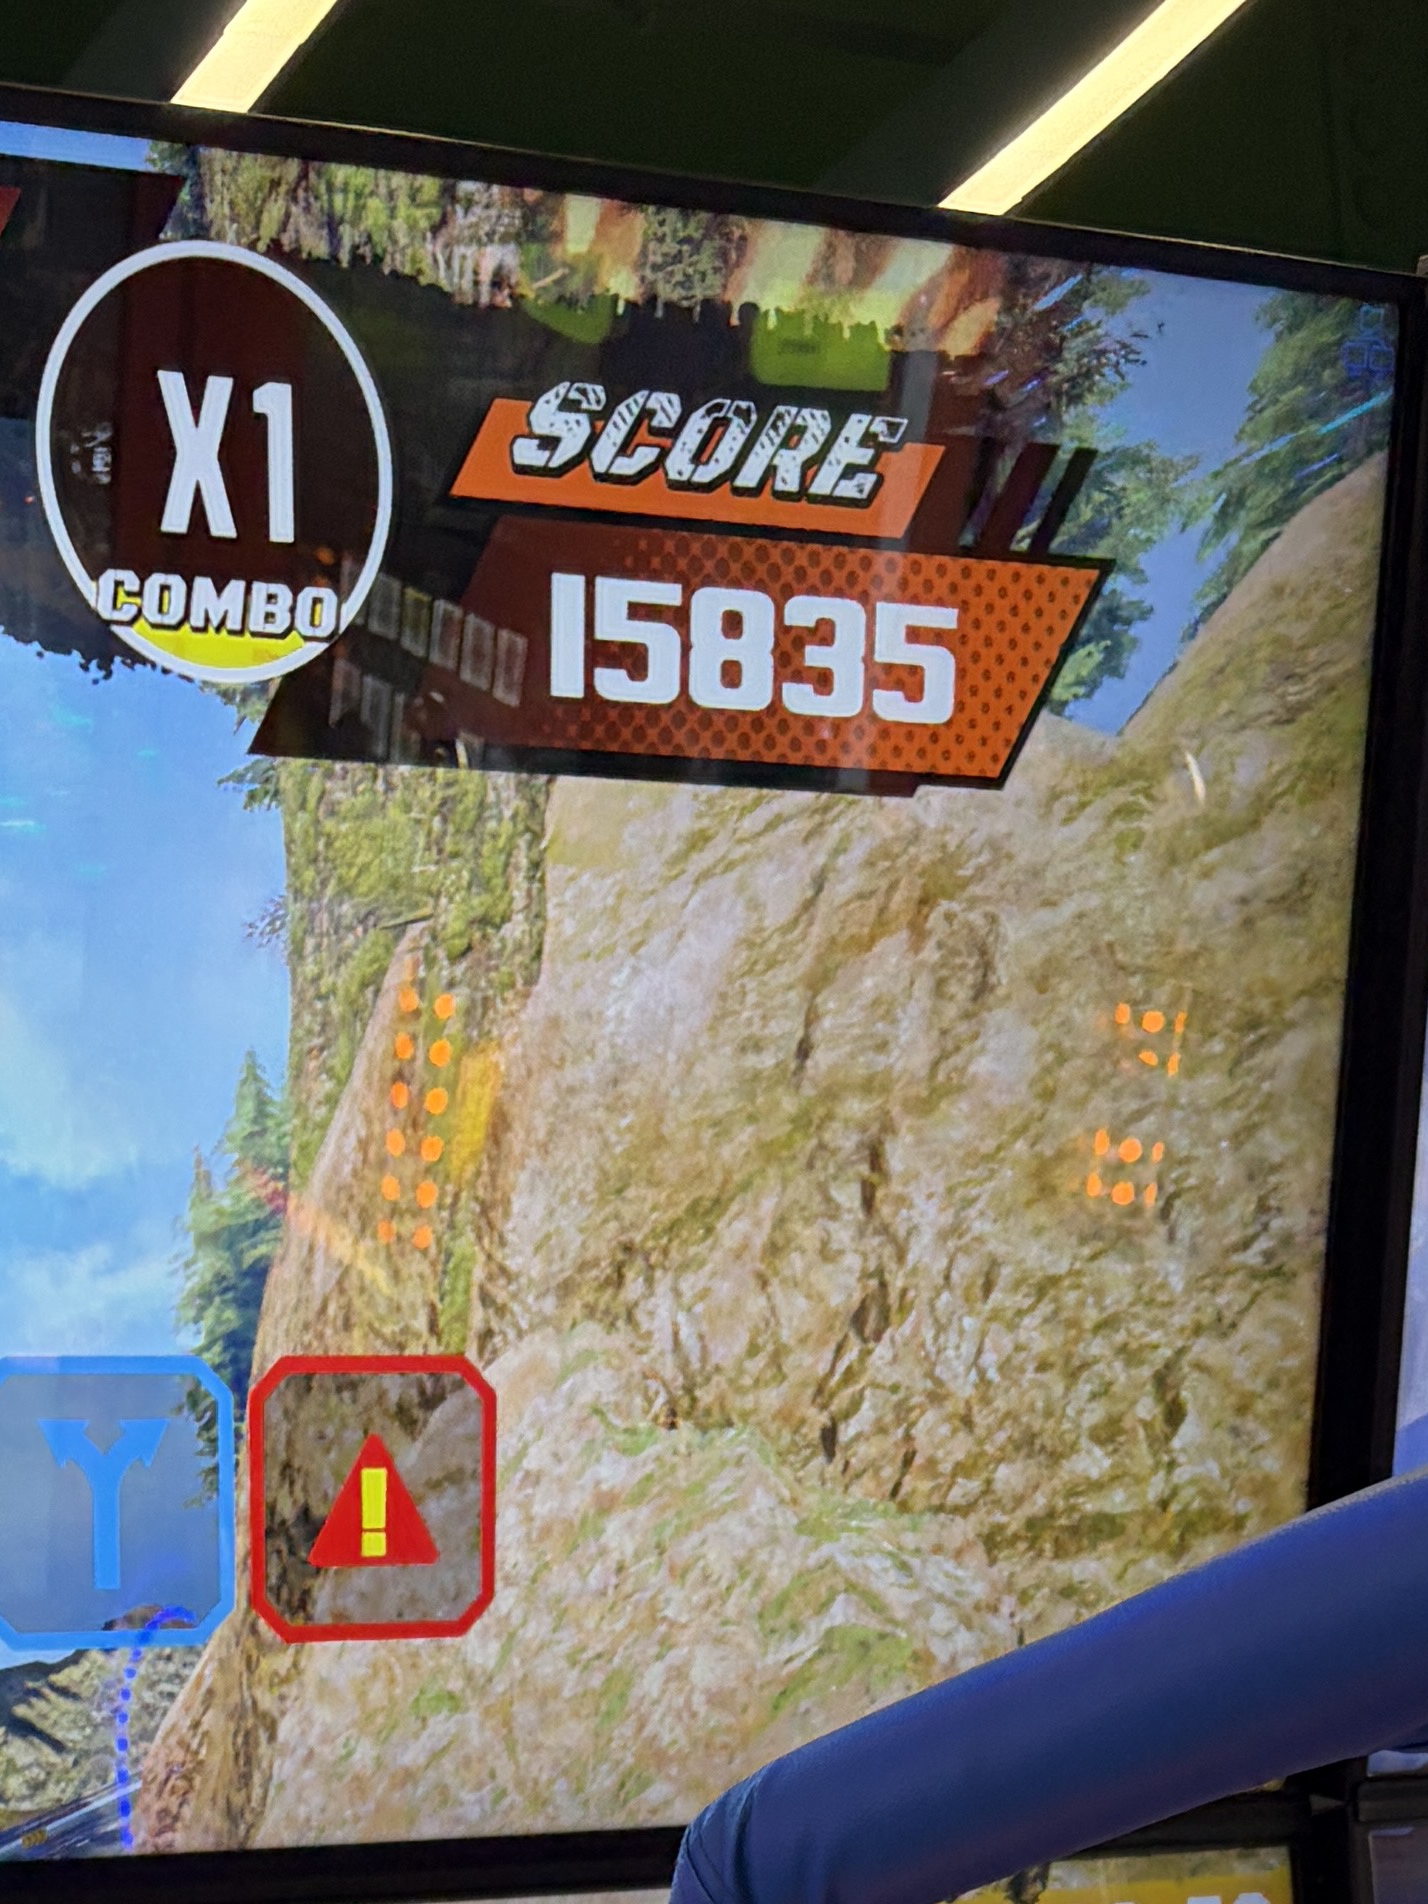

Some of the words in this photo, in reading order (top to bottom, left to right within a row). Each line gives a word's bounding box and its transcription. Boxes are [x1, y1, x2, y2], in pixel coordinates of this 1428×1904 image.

[156, 368, 296, 544] X1
[510, 380, 906, 500] SCORE
[95, 567, 338, 640] COMBO
[549, 571, 960, 725] 15835
